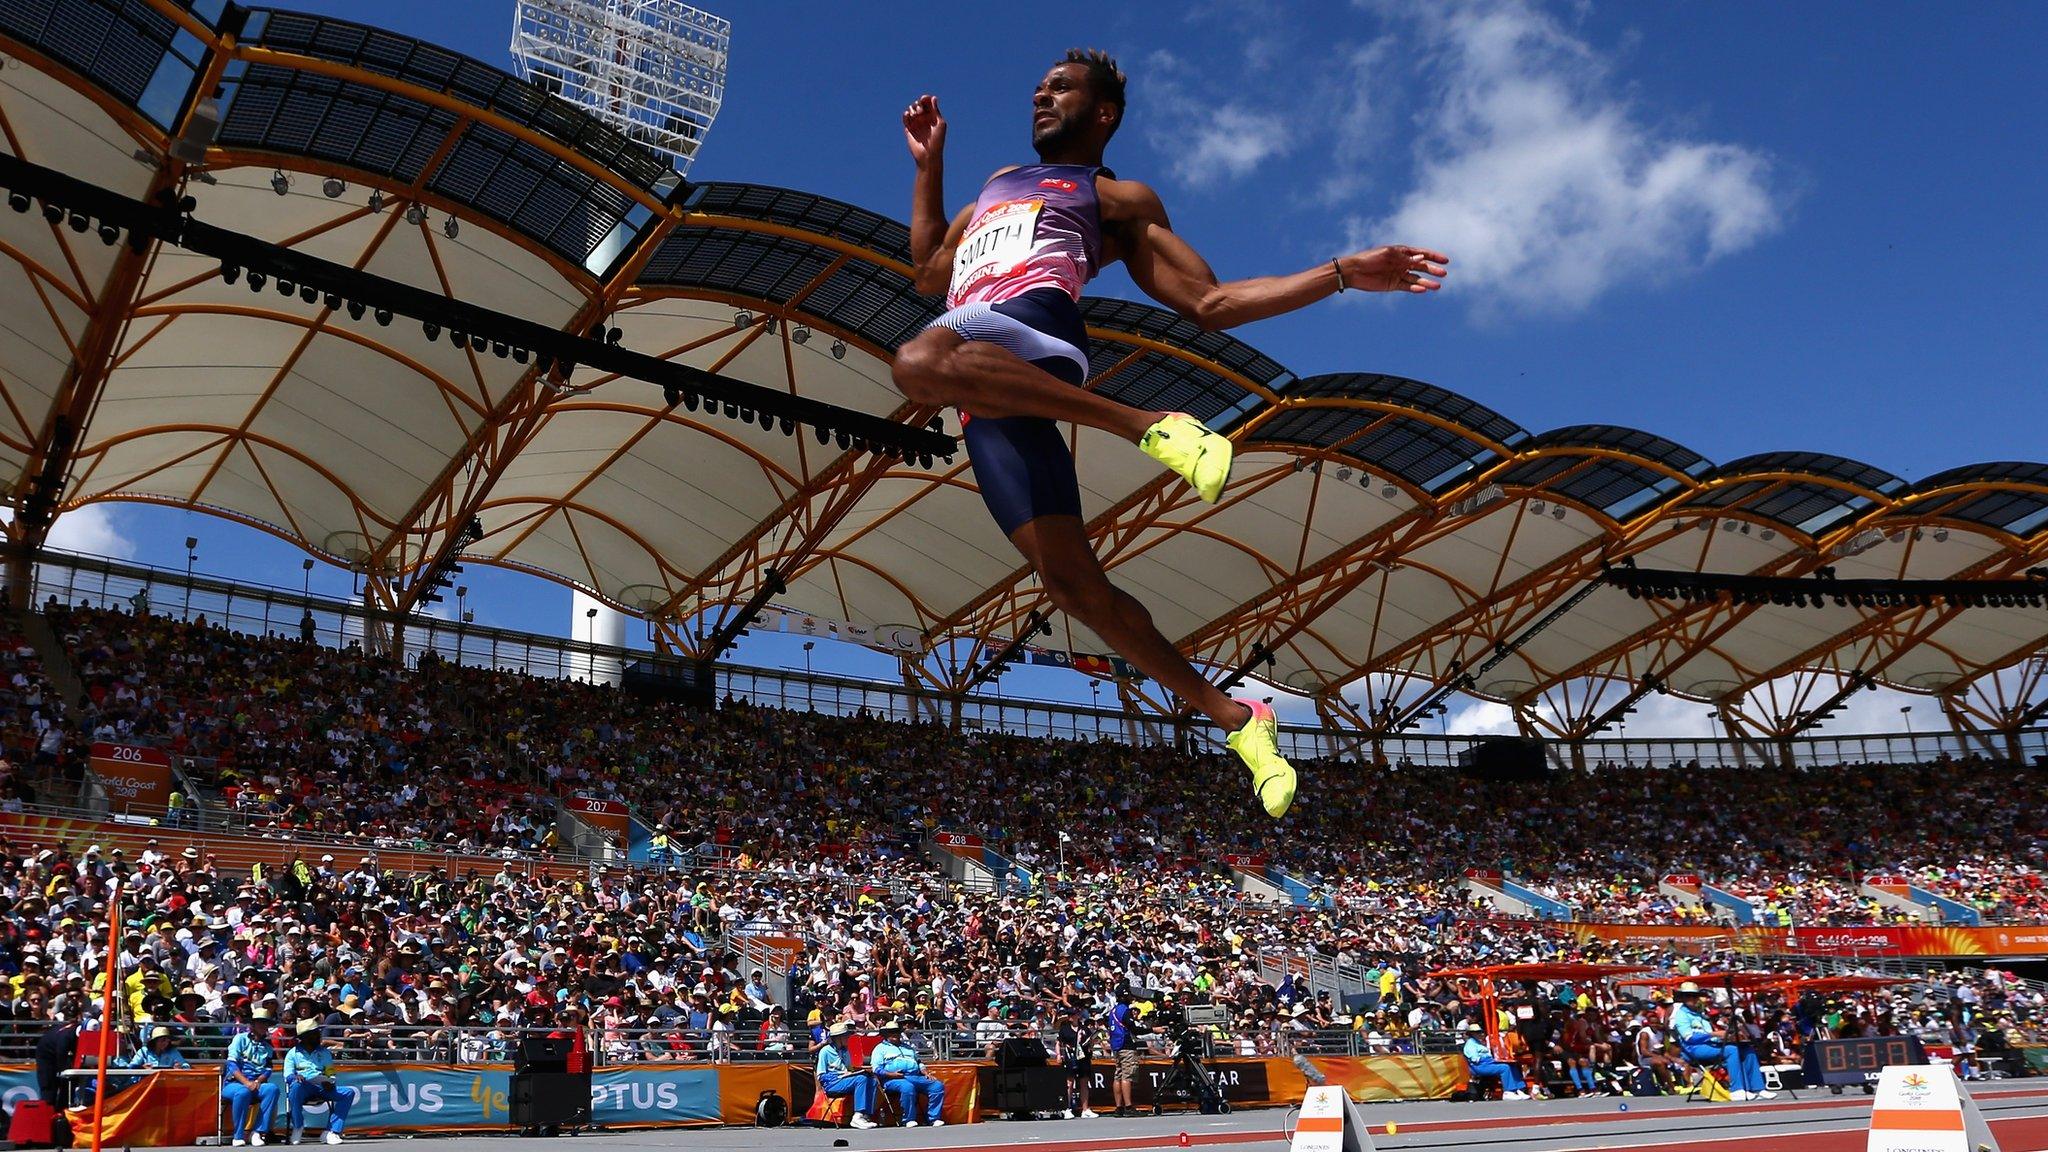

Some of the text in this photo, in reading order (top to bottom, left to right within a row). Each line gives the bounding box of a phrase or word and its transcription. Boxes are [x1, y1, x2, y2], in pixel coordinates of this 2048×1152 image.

[958, 222, 1023, 277] SMITH
[113, 746, 142, 761] 206
[126, 777, 157, 790] Coast
[586, 800, 608, 812] 207
[949, 834, 967, 845] 208
[1236, 856, 1251, 865] 209
[1474, 869, 1488, 878] 210
[591, 1082, 678, 1110] PTUS
